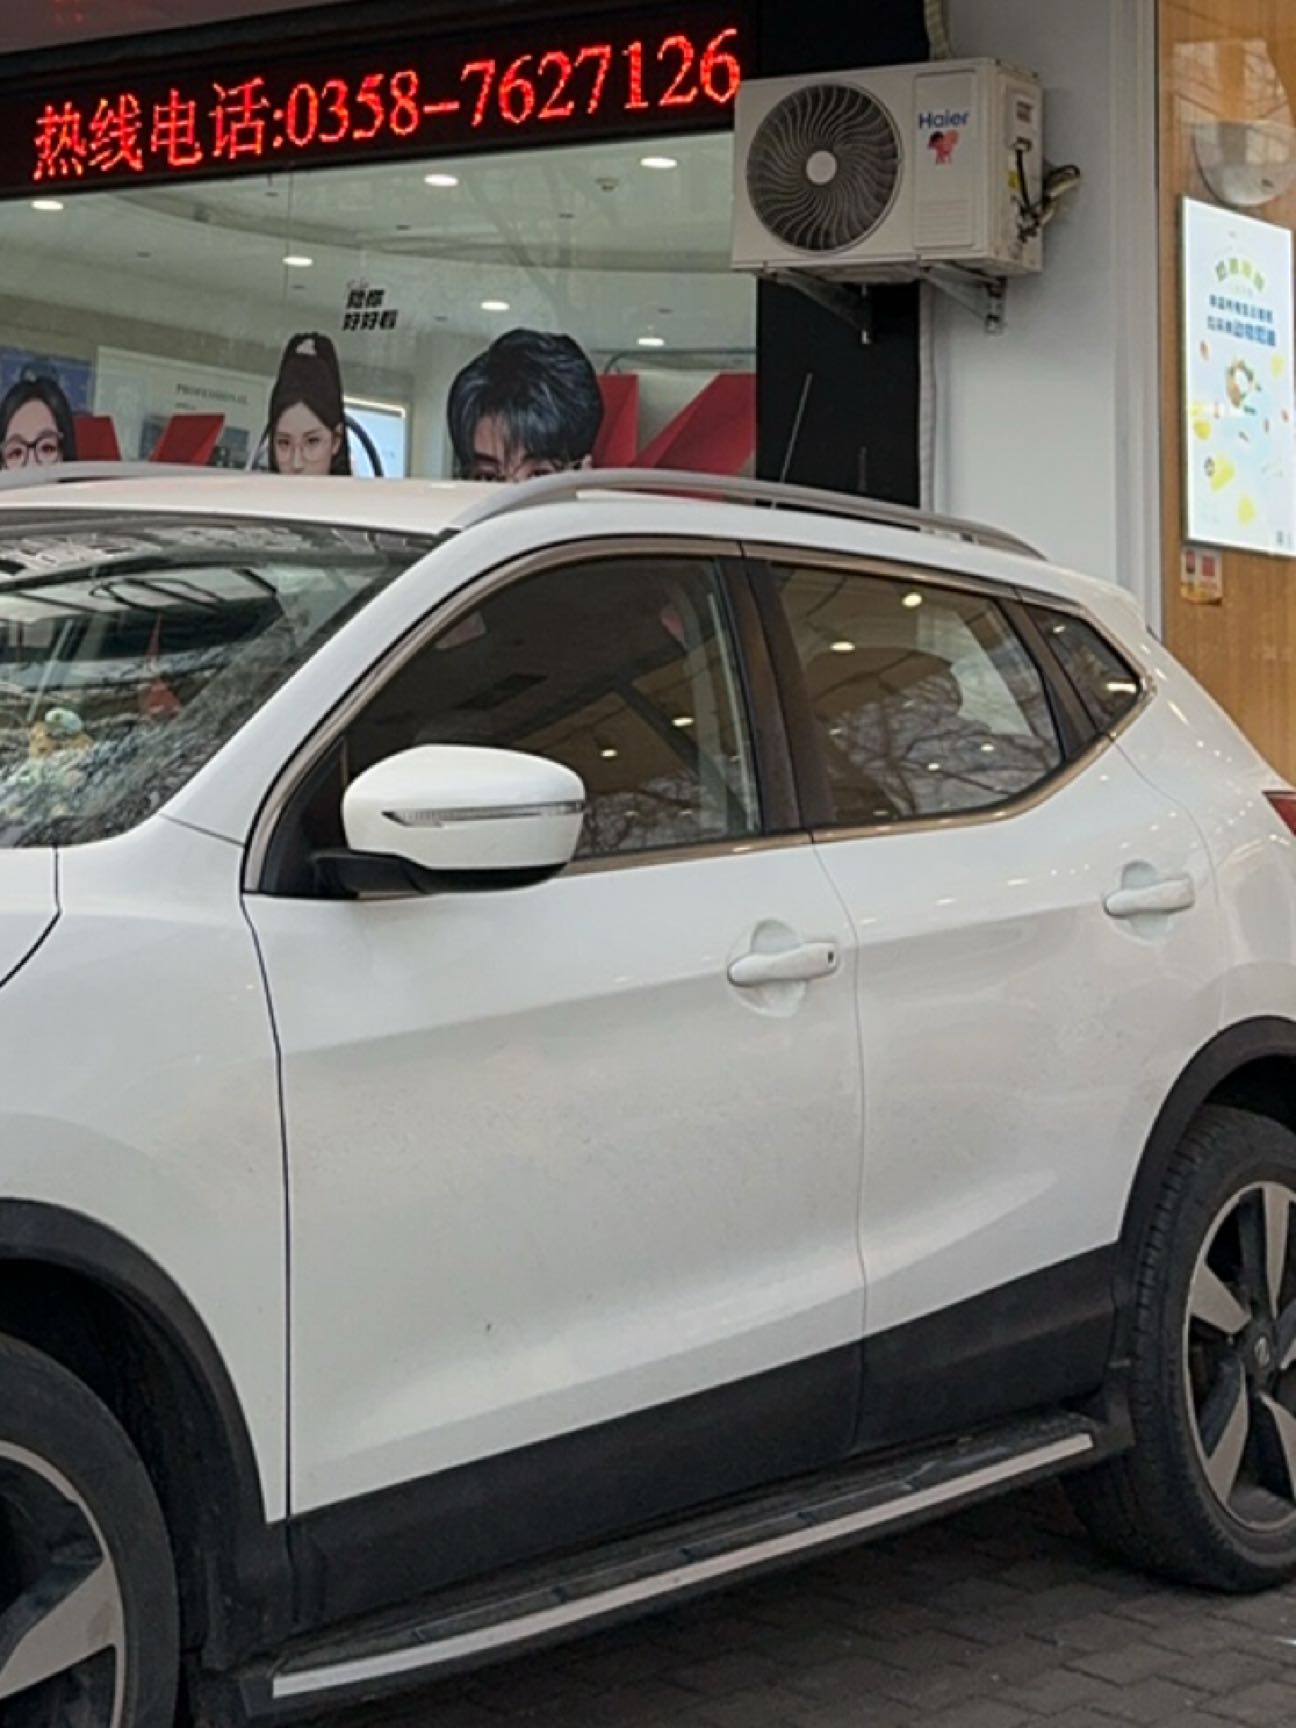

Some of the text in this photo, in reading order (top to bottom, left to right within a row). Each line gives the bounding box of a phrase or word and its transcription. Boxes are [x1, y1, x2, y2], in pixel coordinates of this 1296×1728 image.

[33, 28, 741, 181] 热线电话:0358-7627126
[918, 110, 970, 129] Haier
